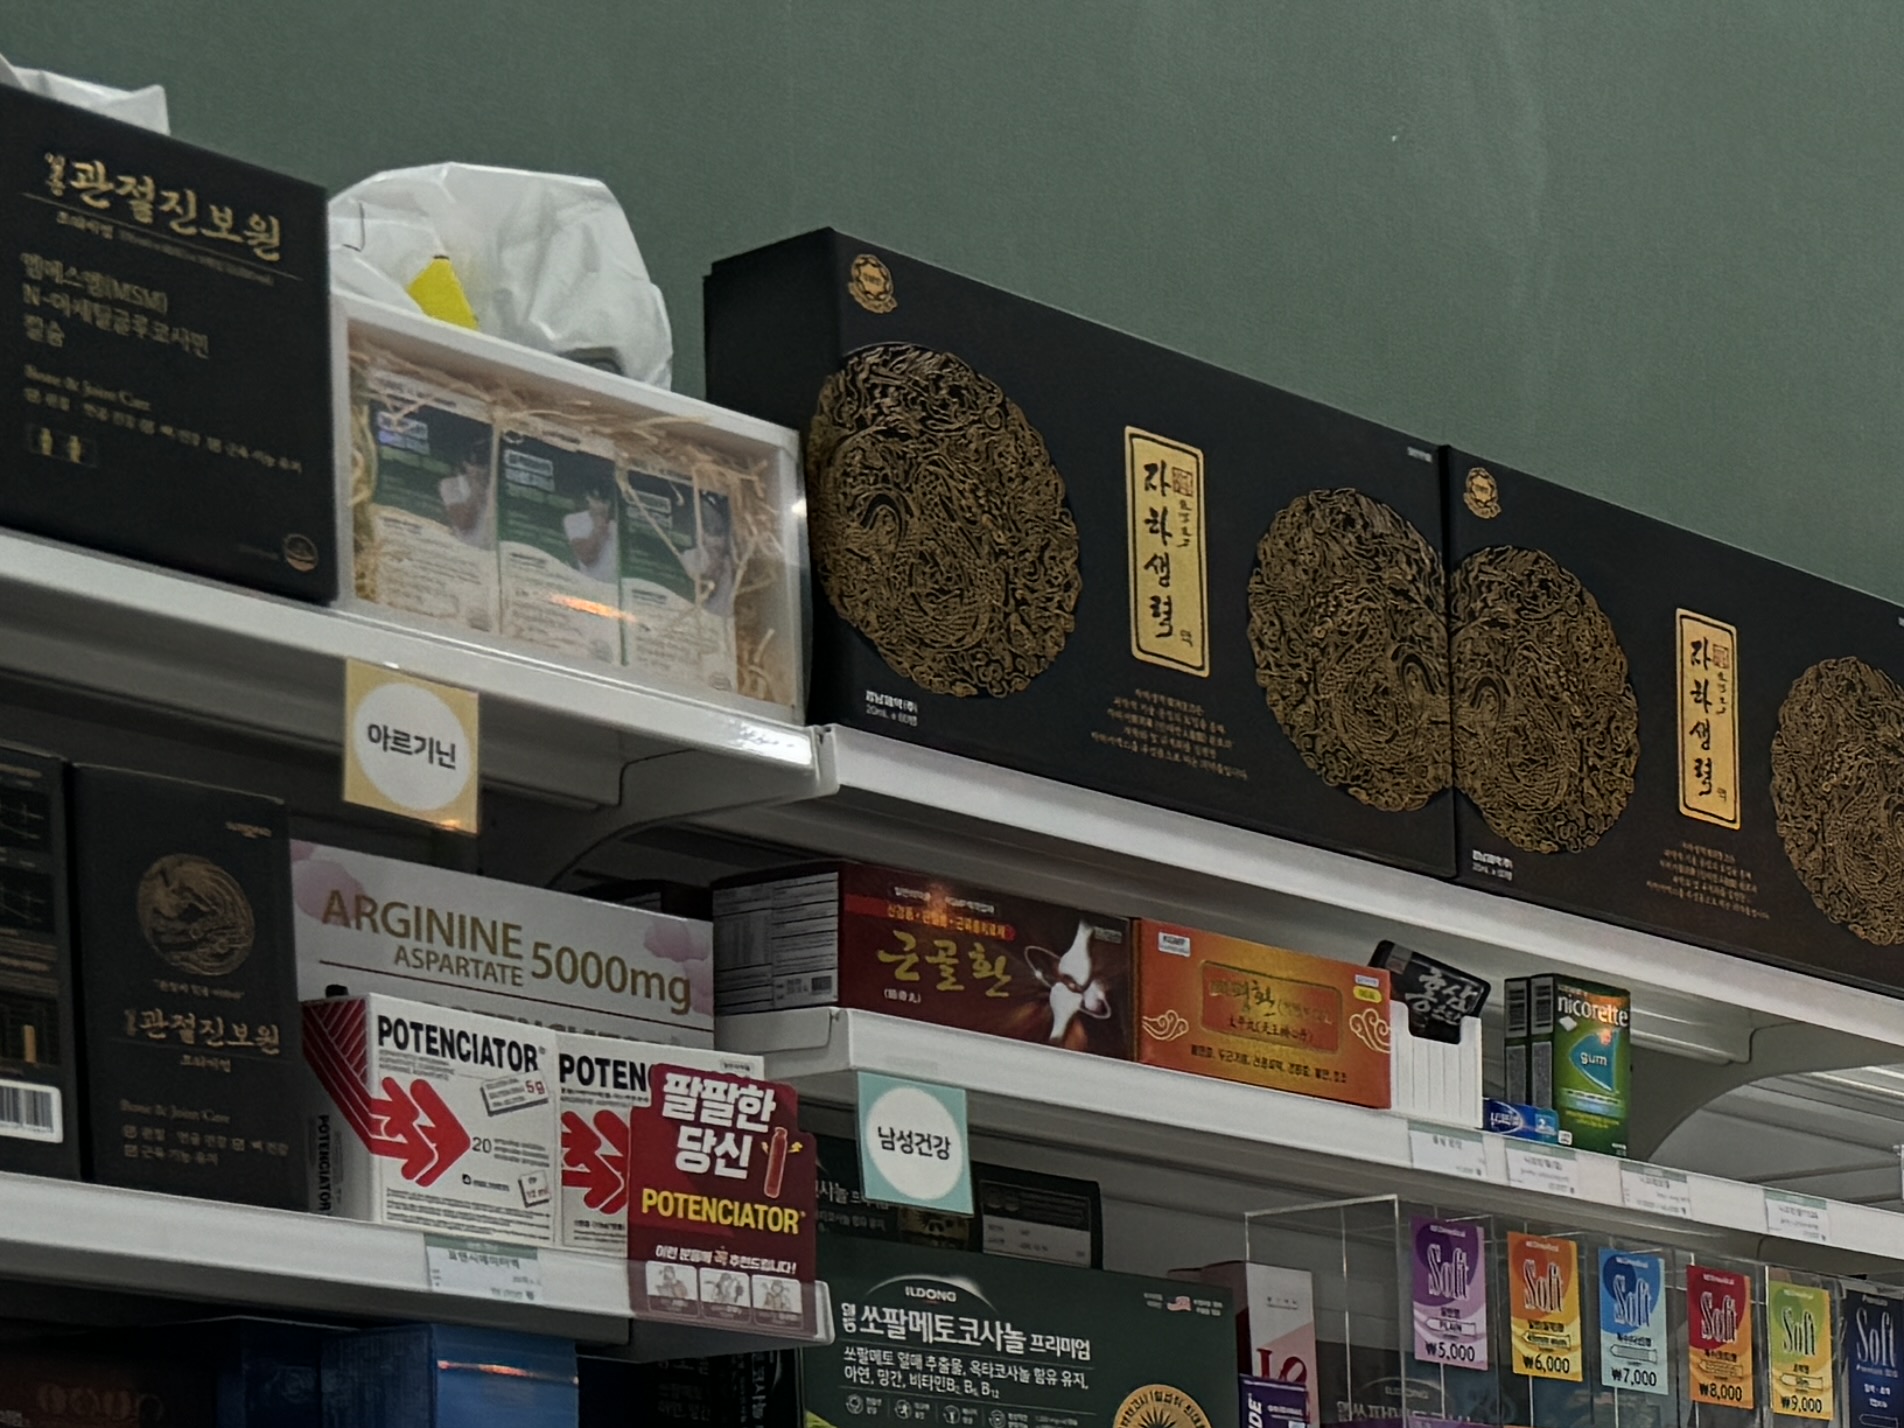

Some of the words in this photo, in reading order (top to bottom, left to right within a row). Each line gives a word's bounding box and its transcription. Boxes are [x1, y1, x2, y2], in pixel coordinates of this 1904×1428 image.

[368, 723, 457, 770] 아르기닌
[321, 888, 524, 960] ARGININE
[394, 945, 524, 988] ASPARTATE
[530, 941, 693, 1013] 5000mg
[1557, 994, 1628, 1026] nicorette
[377, 1015, 539, 1073] POTENCIATOR
[1580, 1052, 1607, 1071] gum
[663, 1074, 776, 1134] 팔팔한
[473, 1137, 491, 1153] 20
[675, 1128, 752, 1178] 당신
[877, 1127, 951, 1160] 남성건강
[642, 1188, 801, 1234] POTENCIATOR
[905, 1285, 956, 1302] ILDONG
[1428, 1244, 1469, 1301] Soft
[861, 1305, 1027, 1354] 쏘팔메토코사놀
[1030, 1333, 1091, 1359] 프리미엄
[1424, 1343, 1476, 1363] ₩5,000
[1855, 1309, 1898, 1365] Soft
